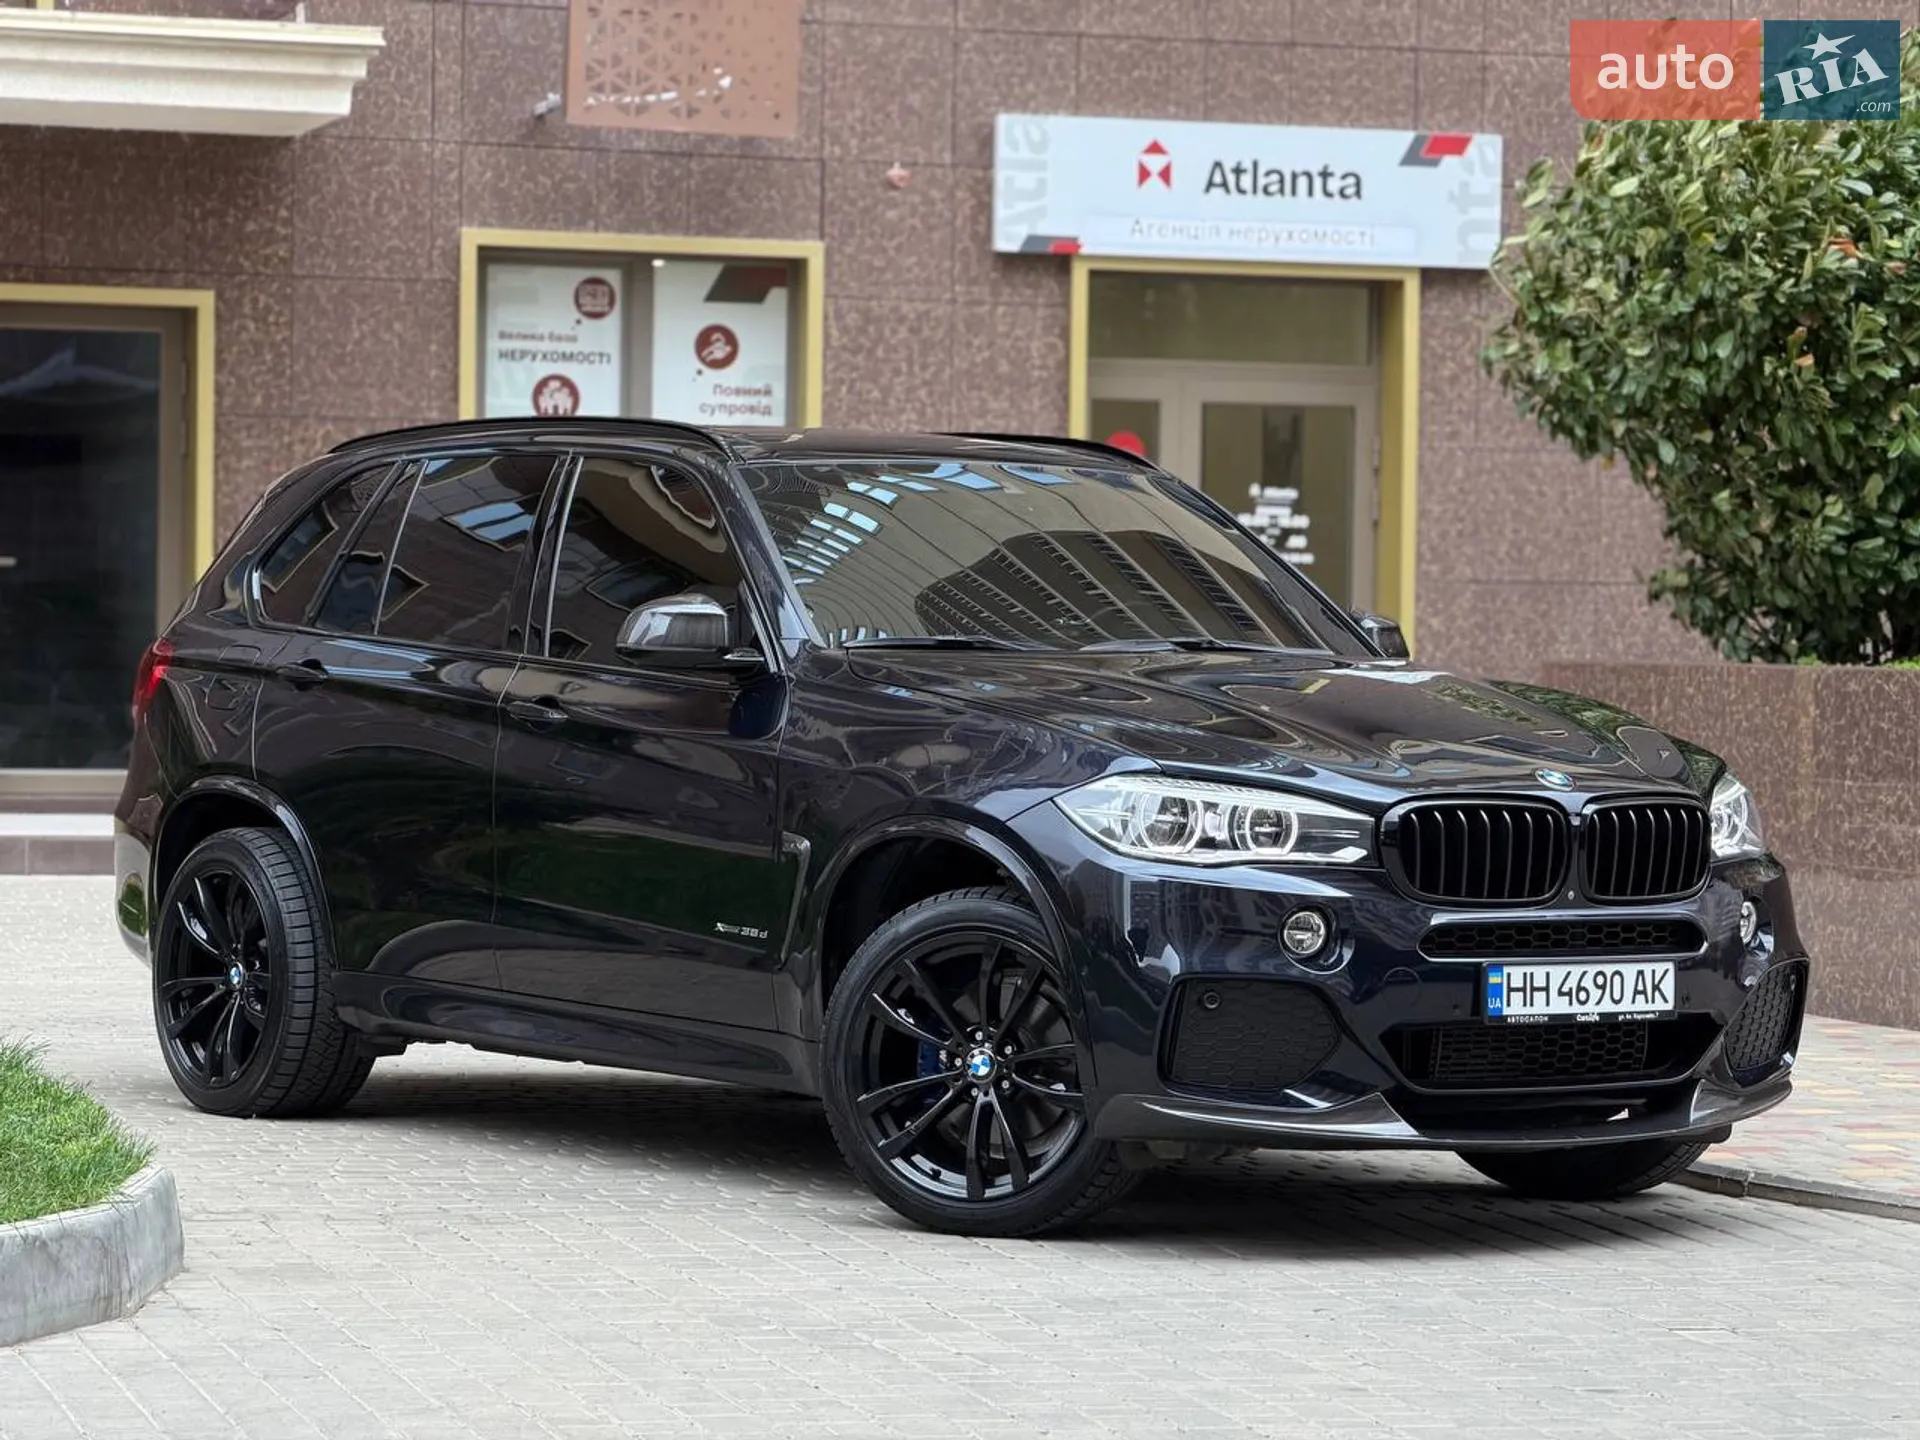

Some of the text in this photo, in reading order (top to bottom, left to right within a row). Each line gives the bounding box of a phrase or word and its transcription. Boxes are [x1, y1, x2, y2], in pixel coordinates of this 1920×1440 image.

[1203, 159, 1363, 201] Atlanta
[1130, 217, 1376, 247] Агенція нерухомості
[498, 348, 612, 365] НЕРУХОМОСТІ
[712, 383, 773, 397] Повний
[699, 401, 773, 417] супровід
[1506, 968, 1670, 1008] HH 4690 AK
[1488, 997, 1501, 1009] UA
